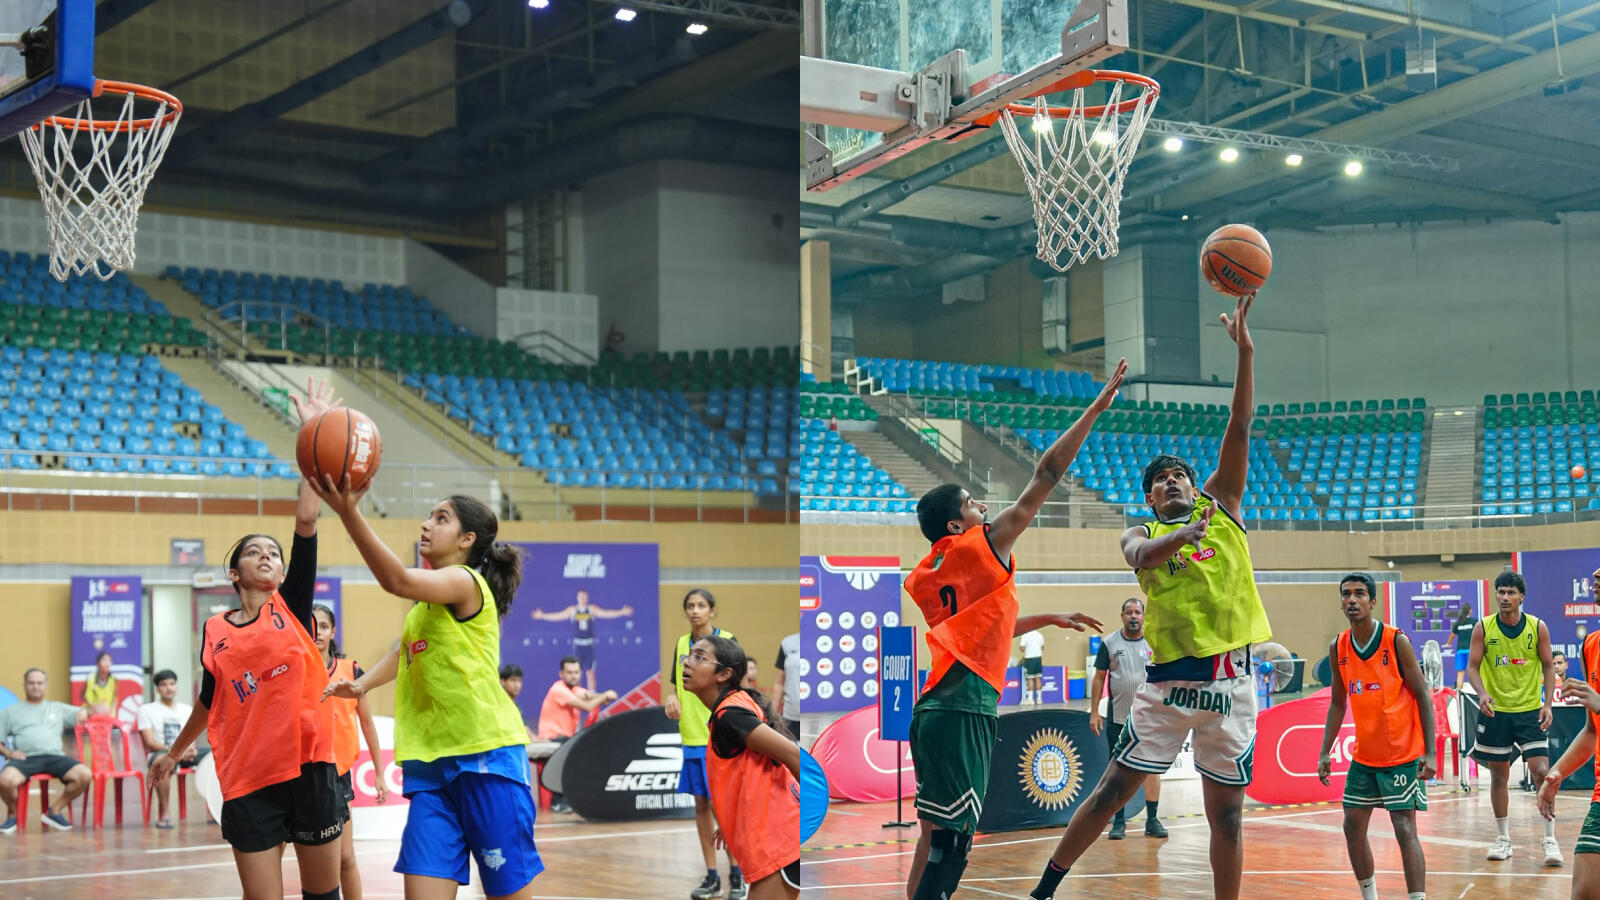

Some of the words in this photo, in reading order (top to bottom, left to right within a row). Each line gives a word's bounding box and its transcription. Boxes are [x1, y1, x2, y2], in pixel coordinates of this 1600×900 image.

[1527, 633, 1534, 650] 2
[1382, 649, 1390, 667] 3
[270, 663, 288, 678] ACG
[883, 655, 911, 681] COURT
[893, 686, 901, 712] 2
[1163, 686, 1233, 718] JORDAN
[1393, 774, 1408, 787] 20
[635, 794, 663, 810] OFFICIAL
[320, 822, 341, 839] HRX
